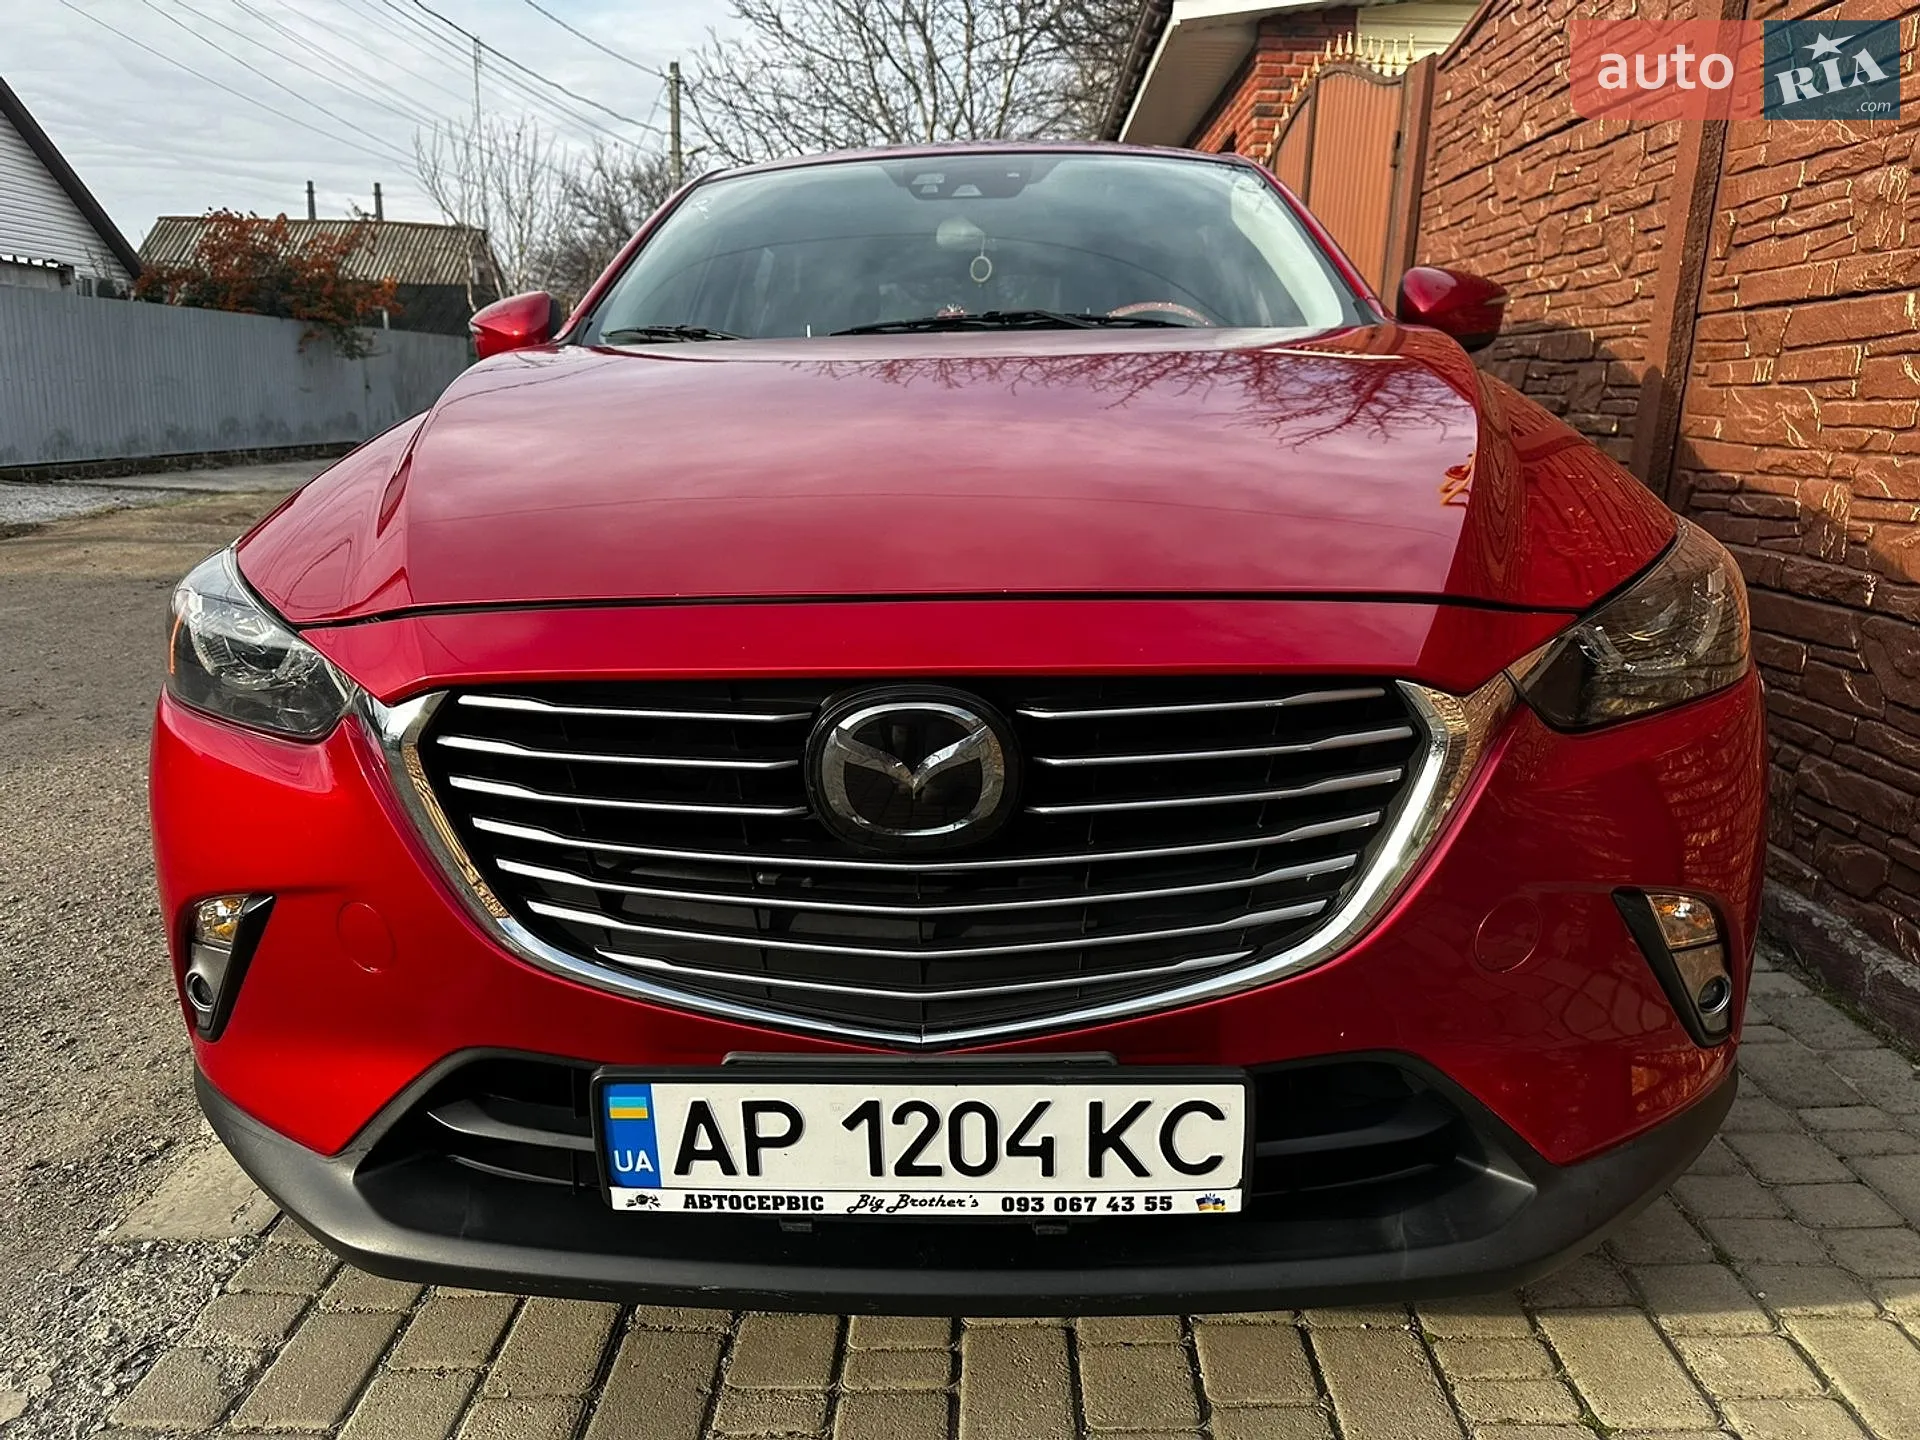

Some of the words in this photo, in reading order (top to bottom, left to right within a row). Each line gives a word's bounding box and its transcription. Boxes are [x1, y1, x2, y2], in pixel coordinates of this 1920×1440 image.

[673, 1099, 805, 1177] AP
[841, 1099, 1055, 1178] 1204
[1088, 1099, 1226, 1178] KC
[613, 1149, 654, 1172] UA
[682, 1193, 824, 1212] АВТОСЕРВІС
[846, 1193, 885, 1214] Big
[885, 1193, 979, 1214] Brother's
[1001, 1196, 1045, 1213] 093
[1053, 1196, 1098, 1213] 067
[1105, 1195, 1135, 1213] 43
[1144, 1195, 1173, 1212] 55
